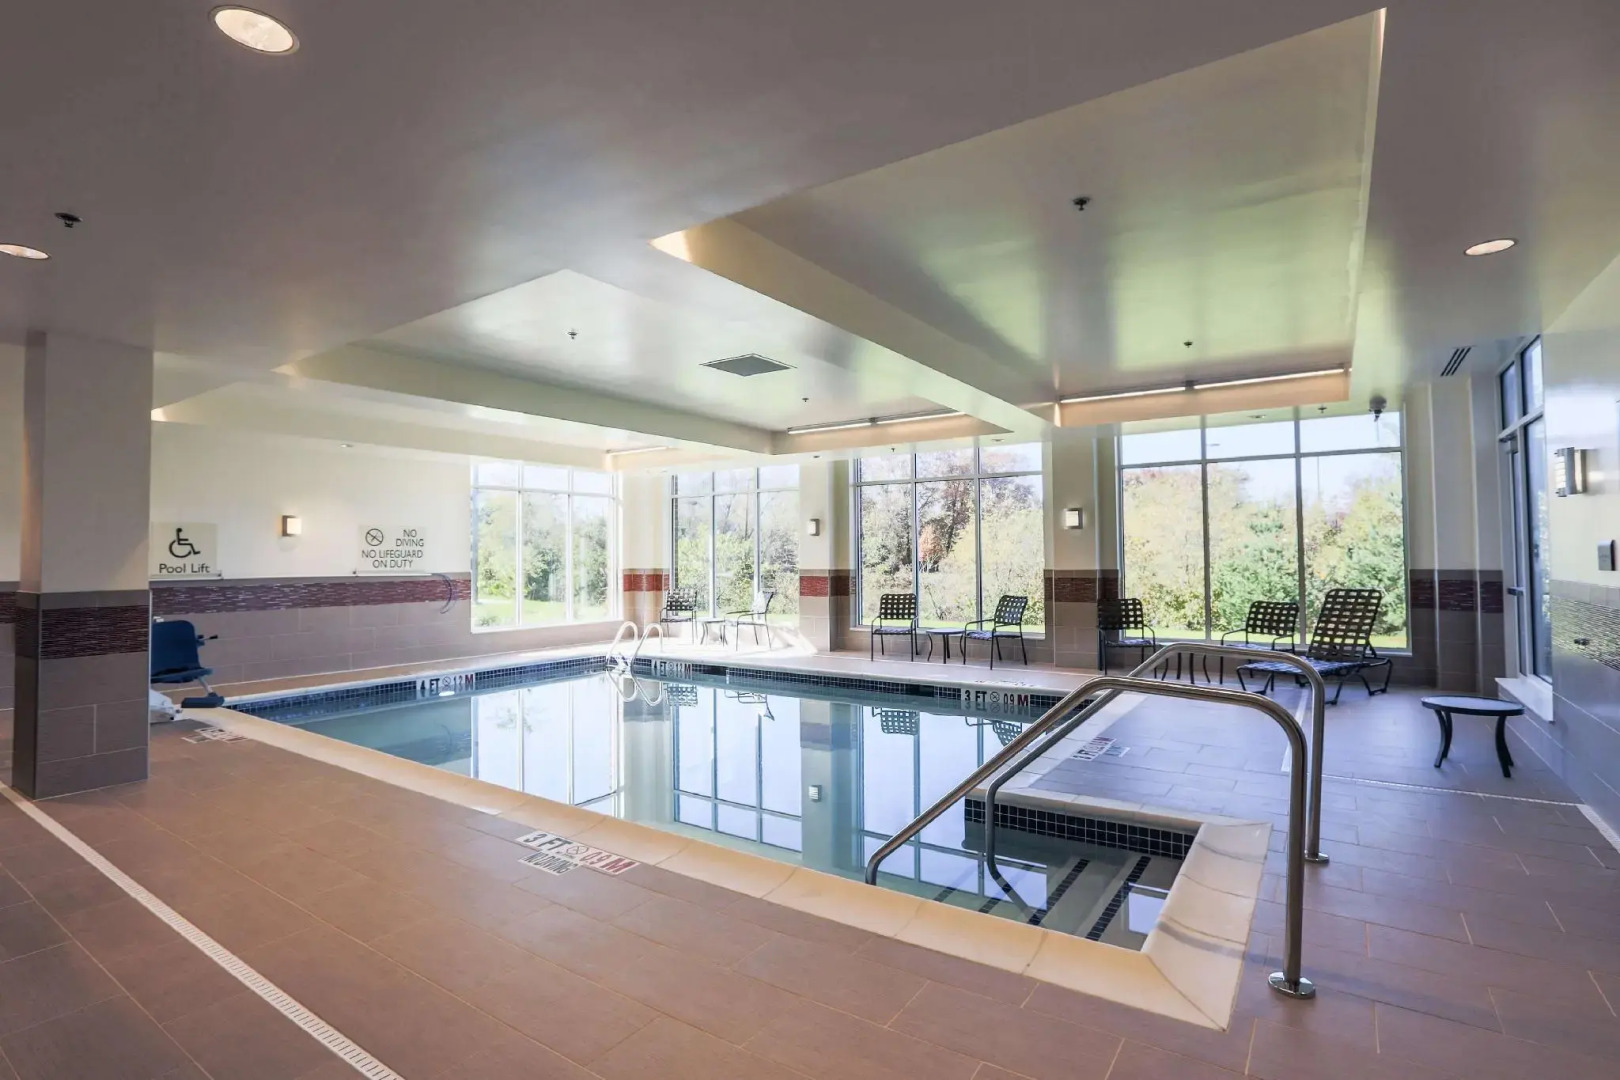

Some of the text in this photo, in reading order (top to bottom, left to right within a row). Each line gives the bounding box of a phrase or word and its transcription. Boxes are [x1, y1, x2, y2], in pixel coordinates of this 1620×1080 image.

[403, 529, 417, 538] NO
[395, 538, 424, 547] DIVING
[361, 549, 423, 558] NO LIFEGUARD
[372, 559, 413, 568] ON DUTY
[159, 563, 210, 574] Pool Lift
[964, 690, 971, 701] 3
[975, 691, 987, 702] FT
[1017, 694, 1029, 706] M
[523, 833, 548, 842] 3
[600, 858, 637, 873] M
